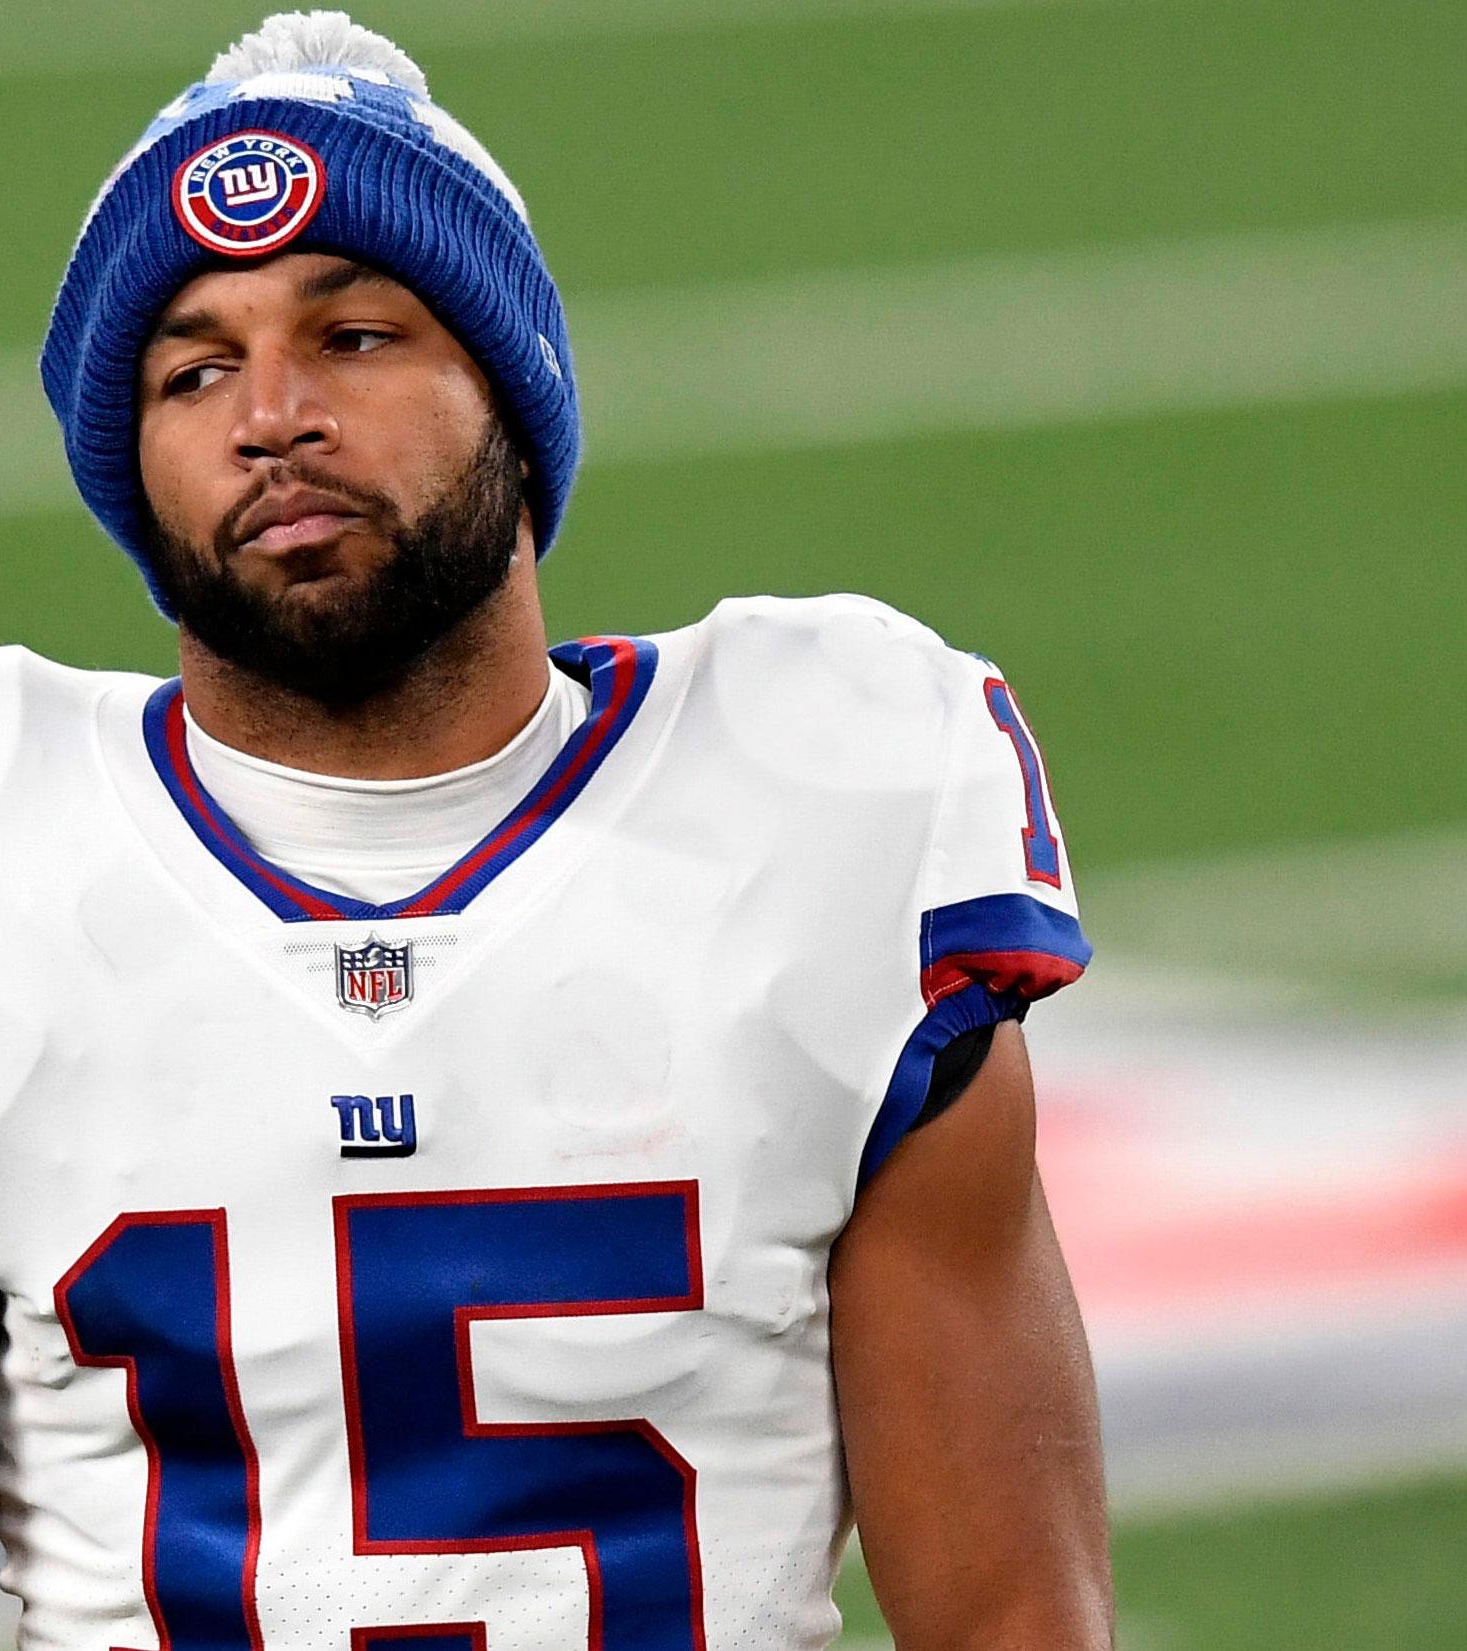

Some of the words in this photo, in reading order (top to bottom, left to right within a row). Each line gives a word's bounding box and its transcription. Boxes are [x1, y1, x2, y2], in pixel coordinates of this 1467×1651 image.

[191, 145, 231, 183] NEW
[243, 139, 303, 168] YORK
[347, 970, 402, 1003] NFL
[53, 1179, 704, 1651] 15
